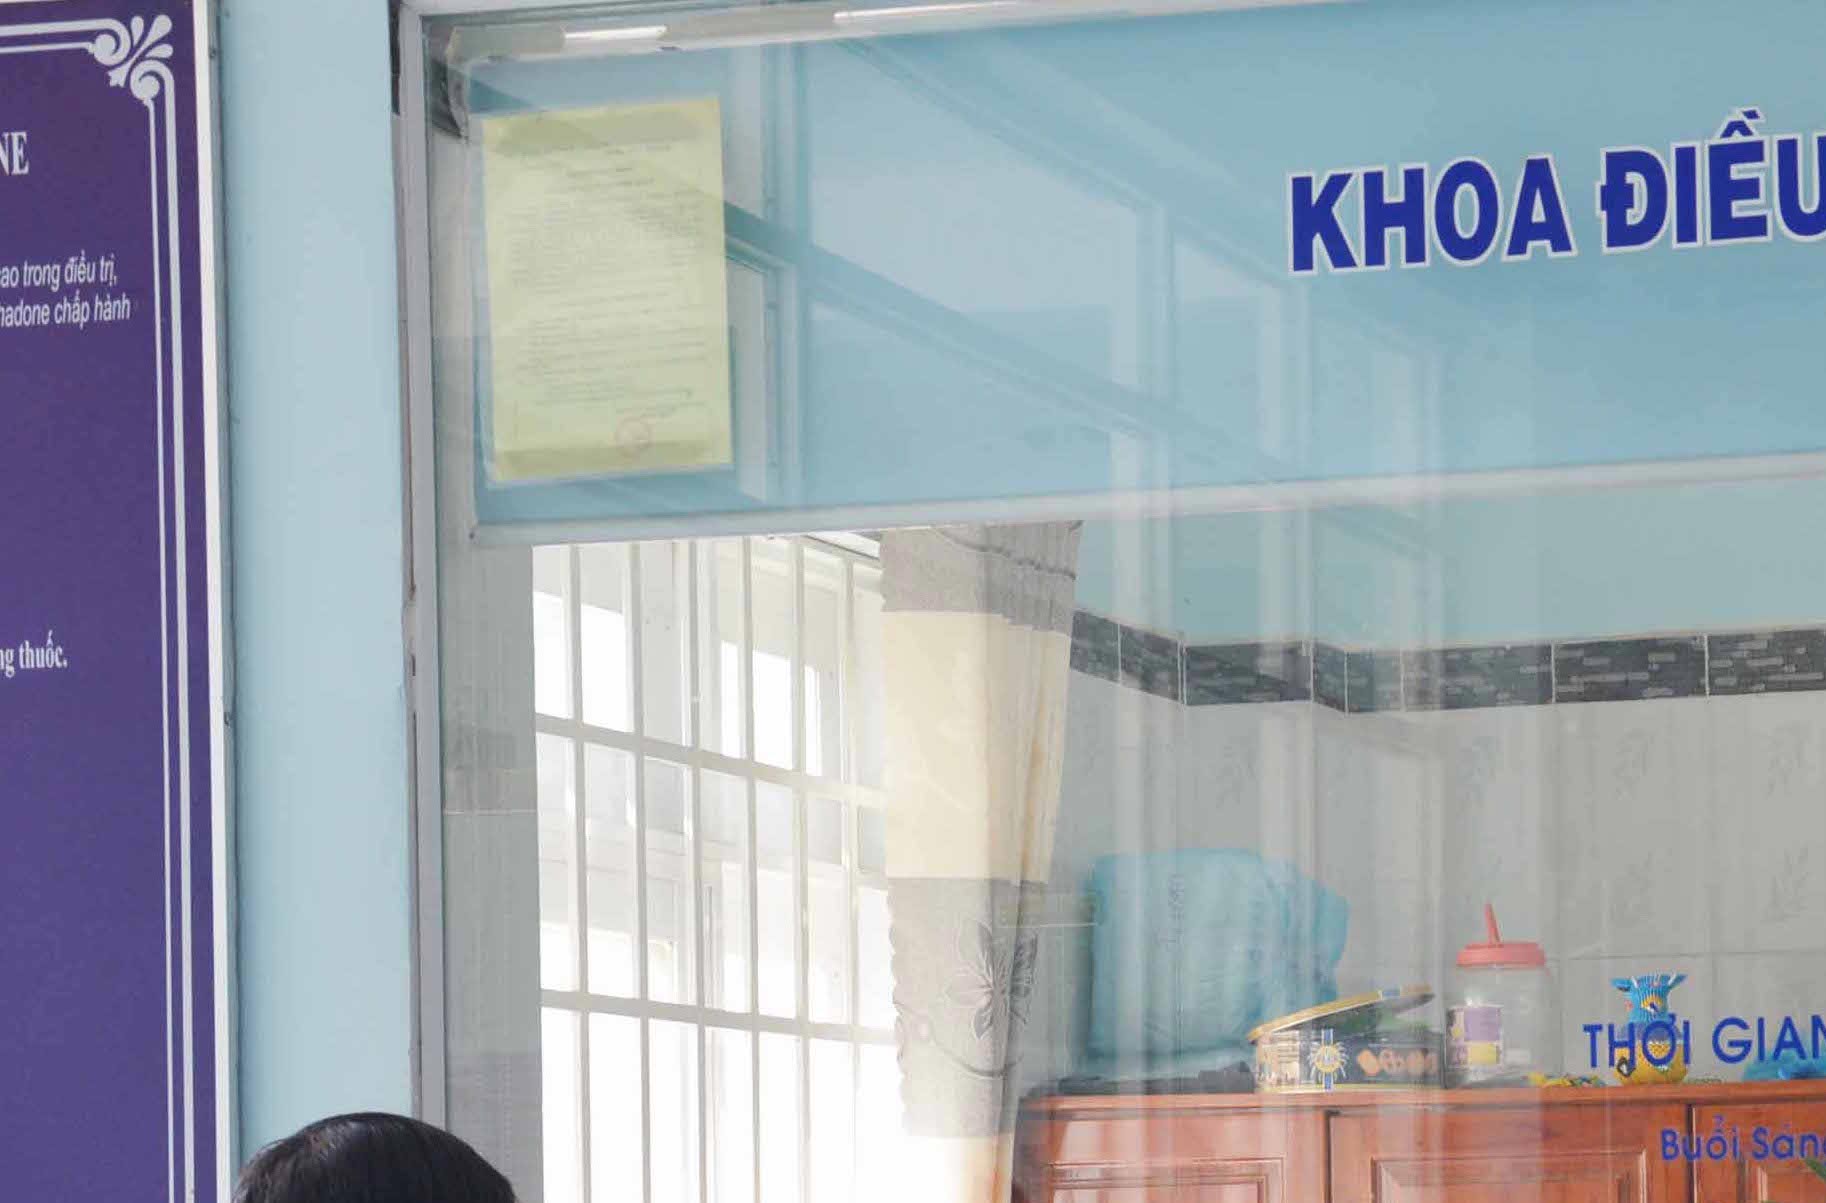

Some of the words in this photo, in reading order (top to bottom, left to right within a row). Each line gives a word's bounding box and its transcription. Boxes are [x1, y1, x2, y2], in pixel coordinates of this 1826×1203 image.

[1289, 155, 1575, 272] KHOA
[24, 261, 60, 292] trong
[64, 250, 95, 283] điều
[54, 289, 89, 329] chấp
[94, 293, 130, 321] hành
[19, 629, 68, 669] thuốc.
[1661, 1115, 1740, 1160] Buổi
